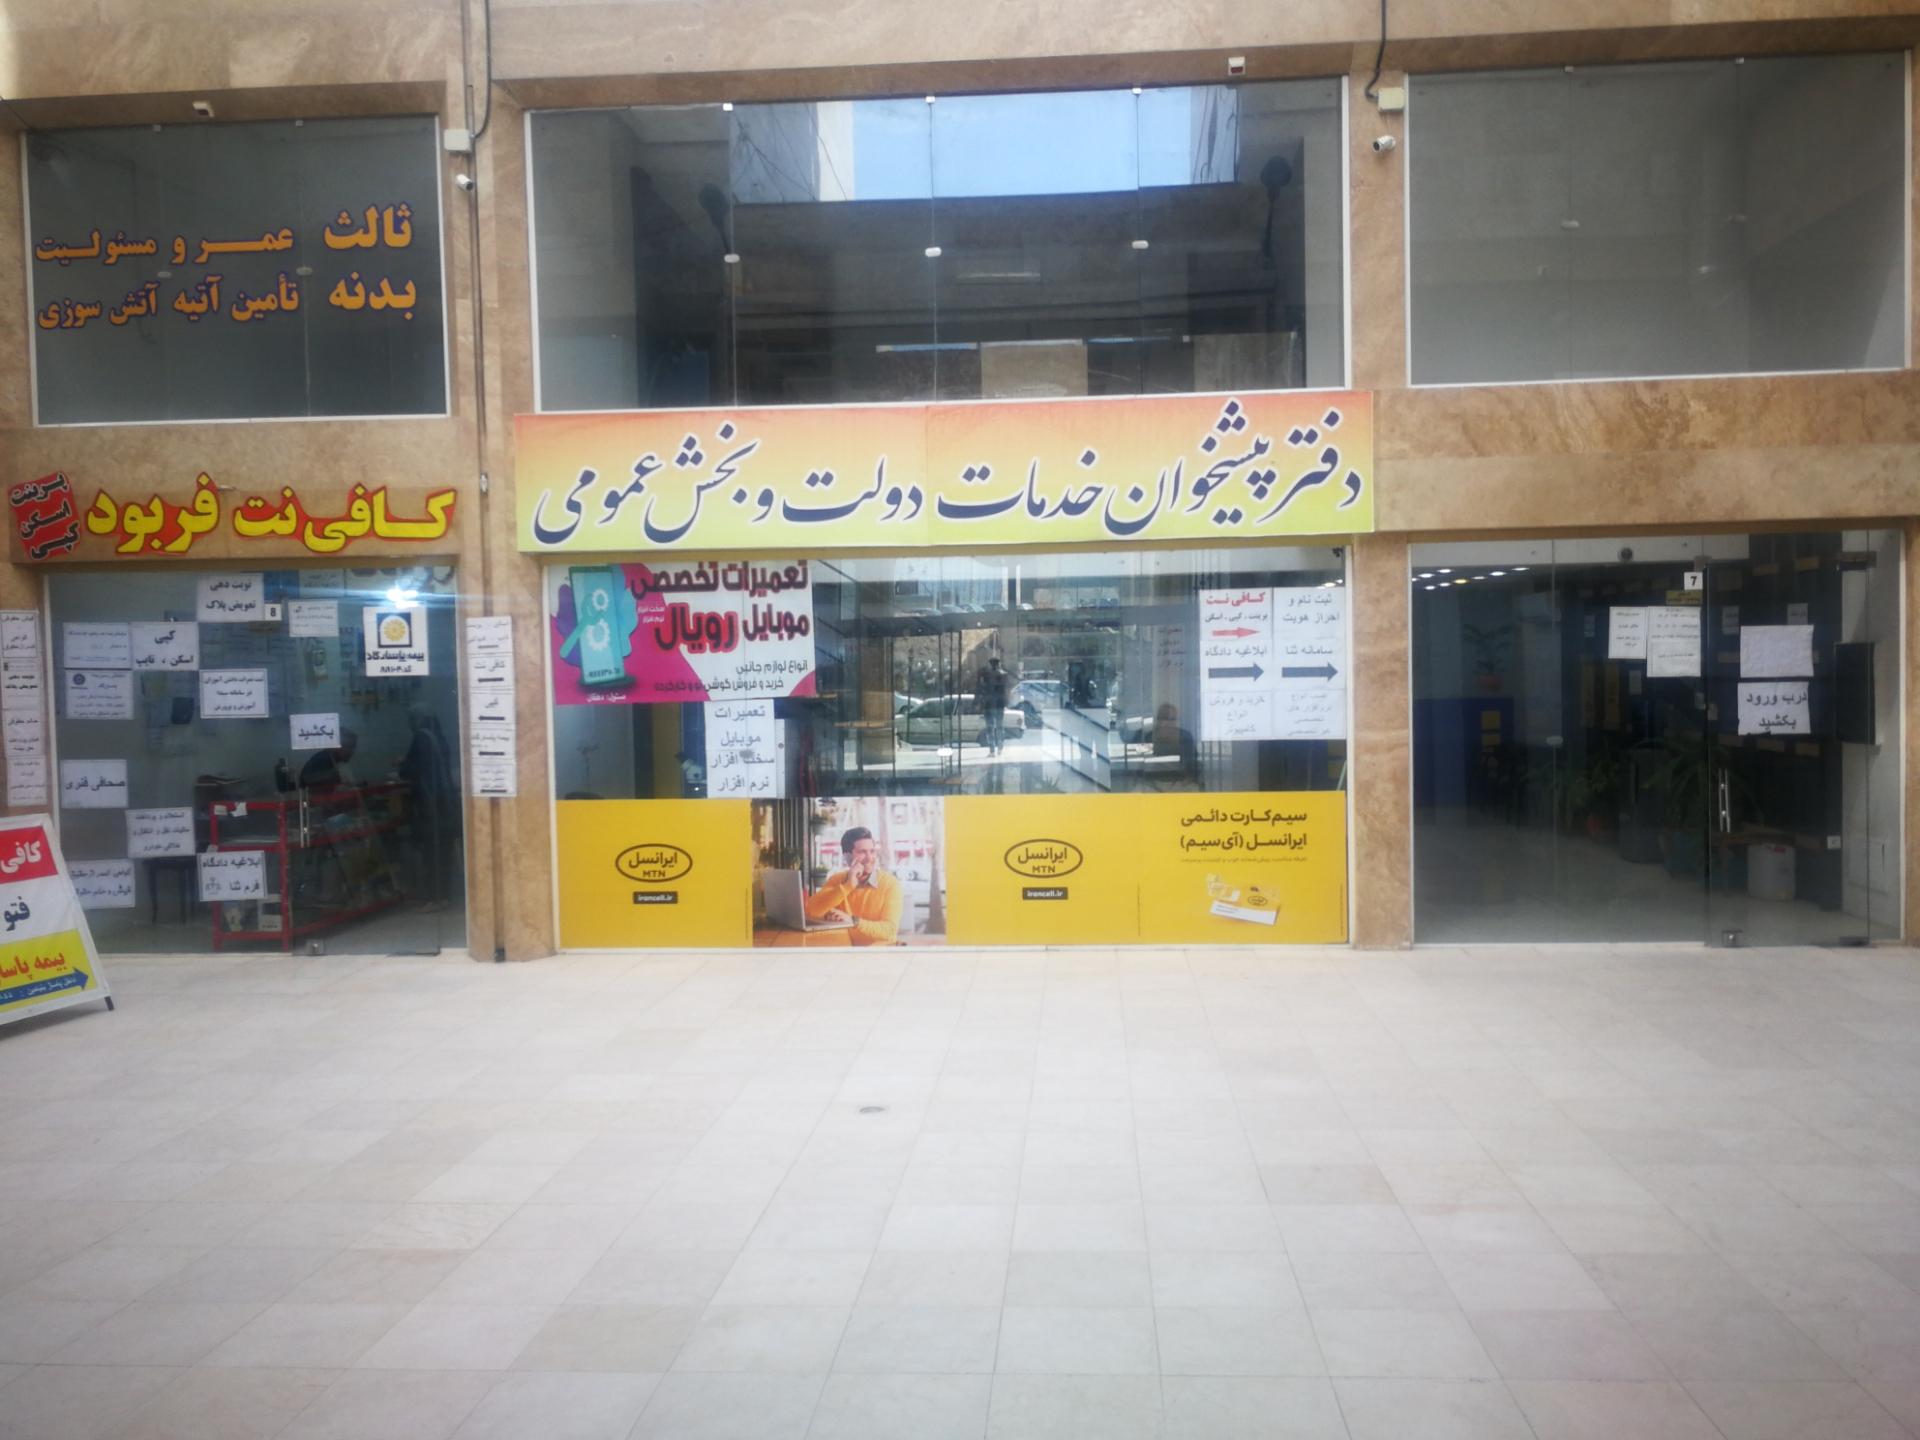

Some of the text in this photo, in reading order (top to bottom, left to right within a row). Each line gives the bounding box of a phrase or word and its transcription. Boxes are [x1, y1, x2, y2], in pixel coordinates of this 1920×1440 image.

[34, 202, 413, 266] ثالث عمر و مسئولیت
[38, 271, 417, 330] بدنه تأمین آتیه آتش سوزی
[533, 400, 1361, 545] دفتر پیشخوان خدمات دولت و بخش عمومی
[11, 473, 68, 506] پرینت
[20, 499, 71, 538] اسکن
[87, 472, 457, 553] کافی نت فربود
[31, 521, 80, 559] کپی
[631, 559, 808, 601] تعمیرات تخصصی
[1690, 575, 1698, 587] 7
[1205, 591, 1266, 608] کافی نت
[270, 607, 276, 617] 8
[654, 603, 811, 652] موبایل رویال
[154, 630, 176, 645] کپی
[170, 655, 194, 667] اسکن
[735, 660, 808, 675] انواع لوازم جانبی
[705, 676, 731, 692] گوشی
[732, 677, 757, 692] فروش
[765, 678, 784, 692] خرید
[1746, 691, 1808, 706] درب ورود
[714, 705, 766, 722] تعمیرات
[1758, 713, 1797, 731] بکشید
[298, 724, 335, 741] بکشید
[720, 731, 761, 747] موبایل
[710, 753, 739, 769] افزار
[65, 775, 126, 792] صحافی فنری
[717, 775, 770, 792] نرم افزار
[1181, 808, 1228, 827] دائمی
[1246, 832, 1307, 851] ایرانسل
[0, 840, 42, 875] کافی
[202, 856, 261, 869] ابلاغیه دادگاه
[628, 852, 678, 869] ایرانسل
[1017, 847, 1068, 864] ایرانسل
[642, 870, 667, 878] MTN
[1032, 865, 1056, 874] MTN
[3, 895, 31, 932] فتو
[0, 951, 67, 981] بیمه پاس
